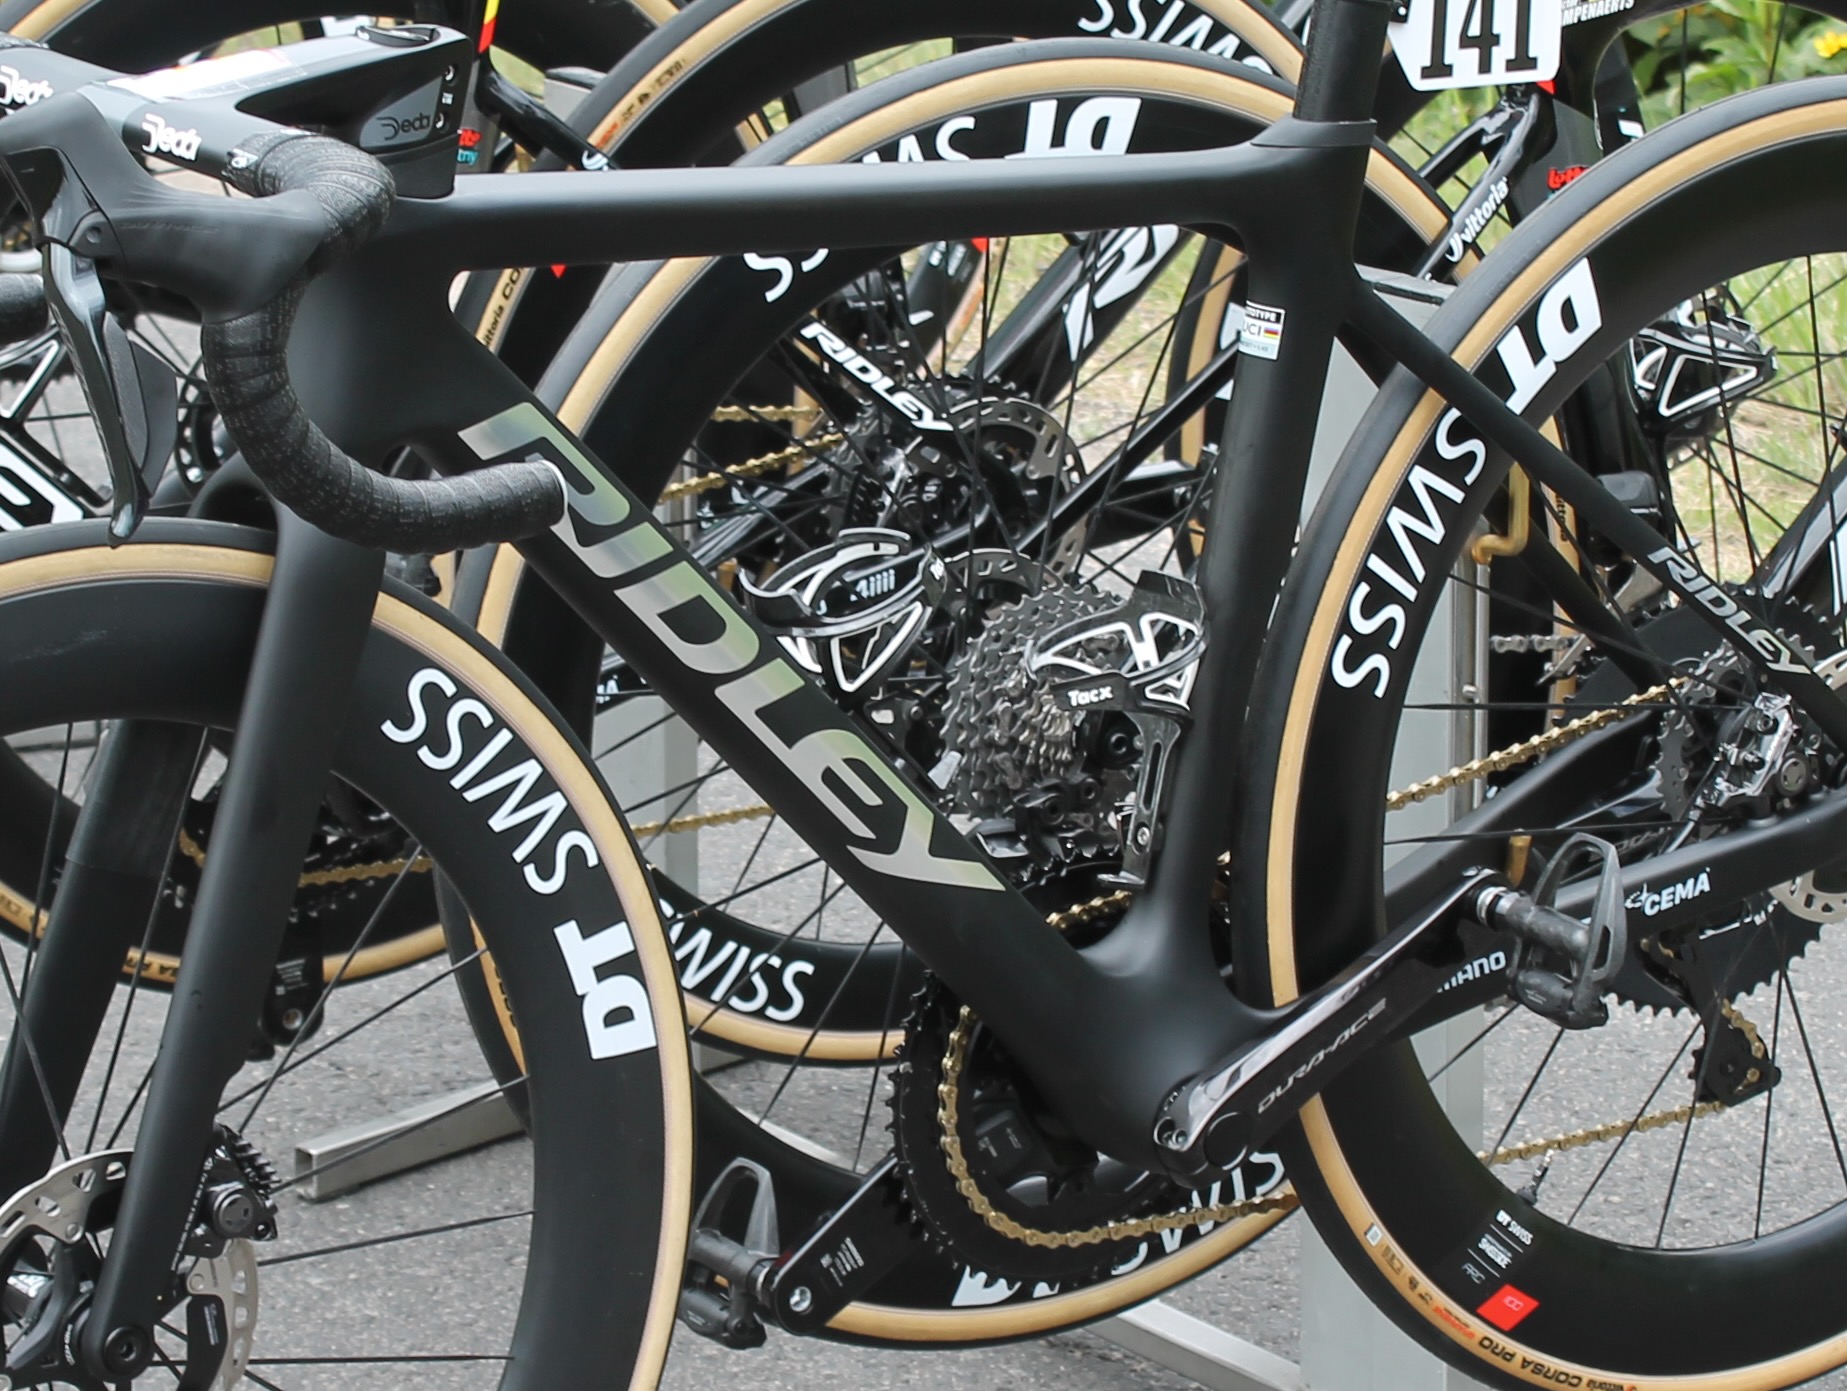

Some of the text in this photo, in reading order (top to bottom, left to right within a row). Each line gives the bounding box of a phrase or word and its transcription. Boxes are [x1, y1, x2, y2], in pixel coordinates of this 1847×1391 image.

[1419, 0, 1539, 80] 141
[799, 321, 955, 432] RIDLEY
[1331, 256, 1603, 699] DT SWISS
[457, 401, 1007, 892] RIDLEY
[1647, 546, 1812, 675] RIDLEY
[1067, 685, 1114, 707] Tacx
[380, 667, 658, 1061] DT SWISS
[1643, 872, 1711, 917] CEMA
[1257, 997, 1387, 1115] DURA-ACE
[1478, 1335, 1517, 1362] PRO
[1520, 1356, 1583, 1388] CORSA
